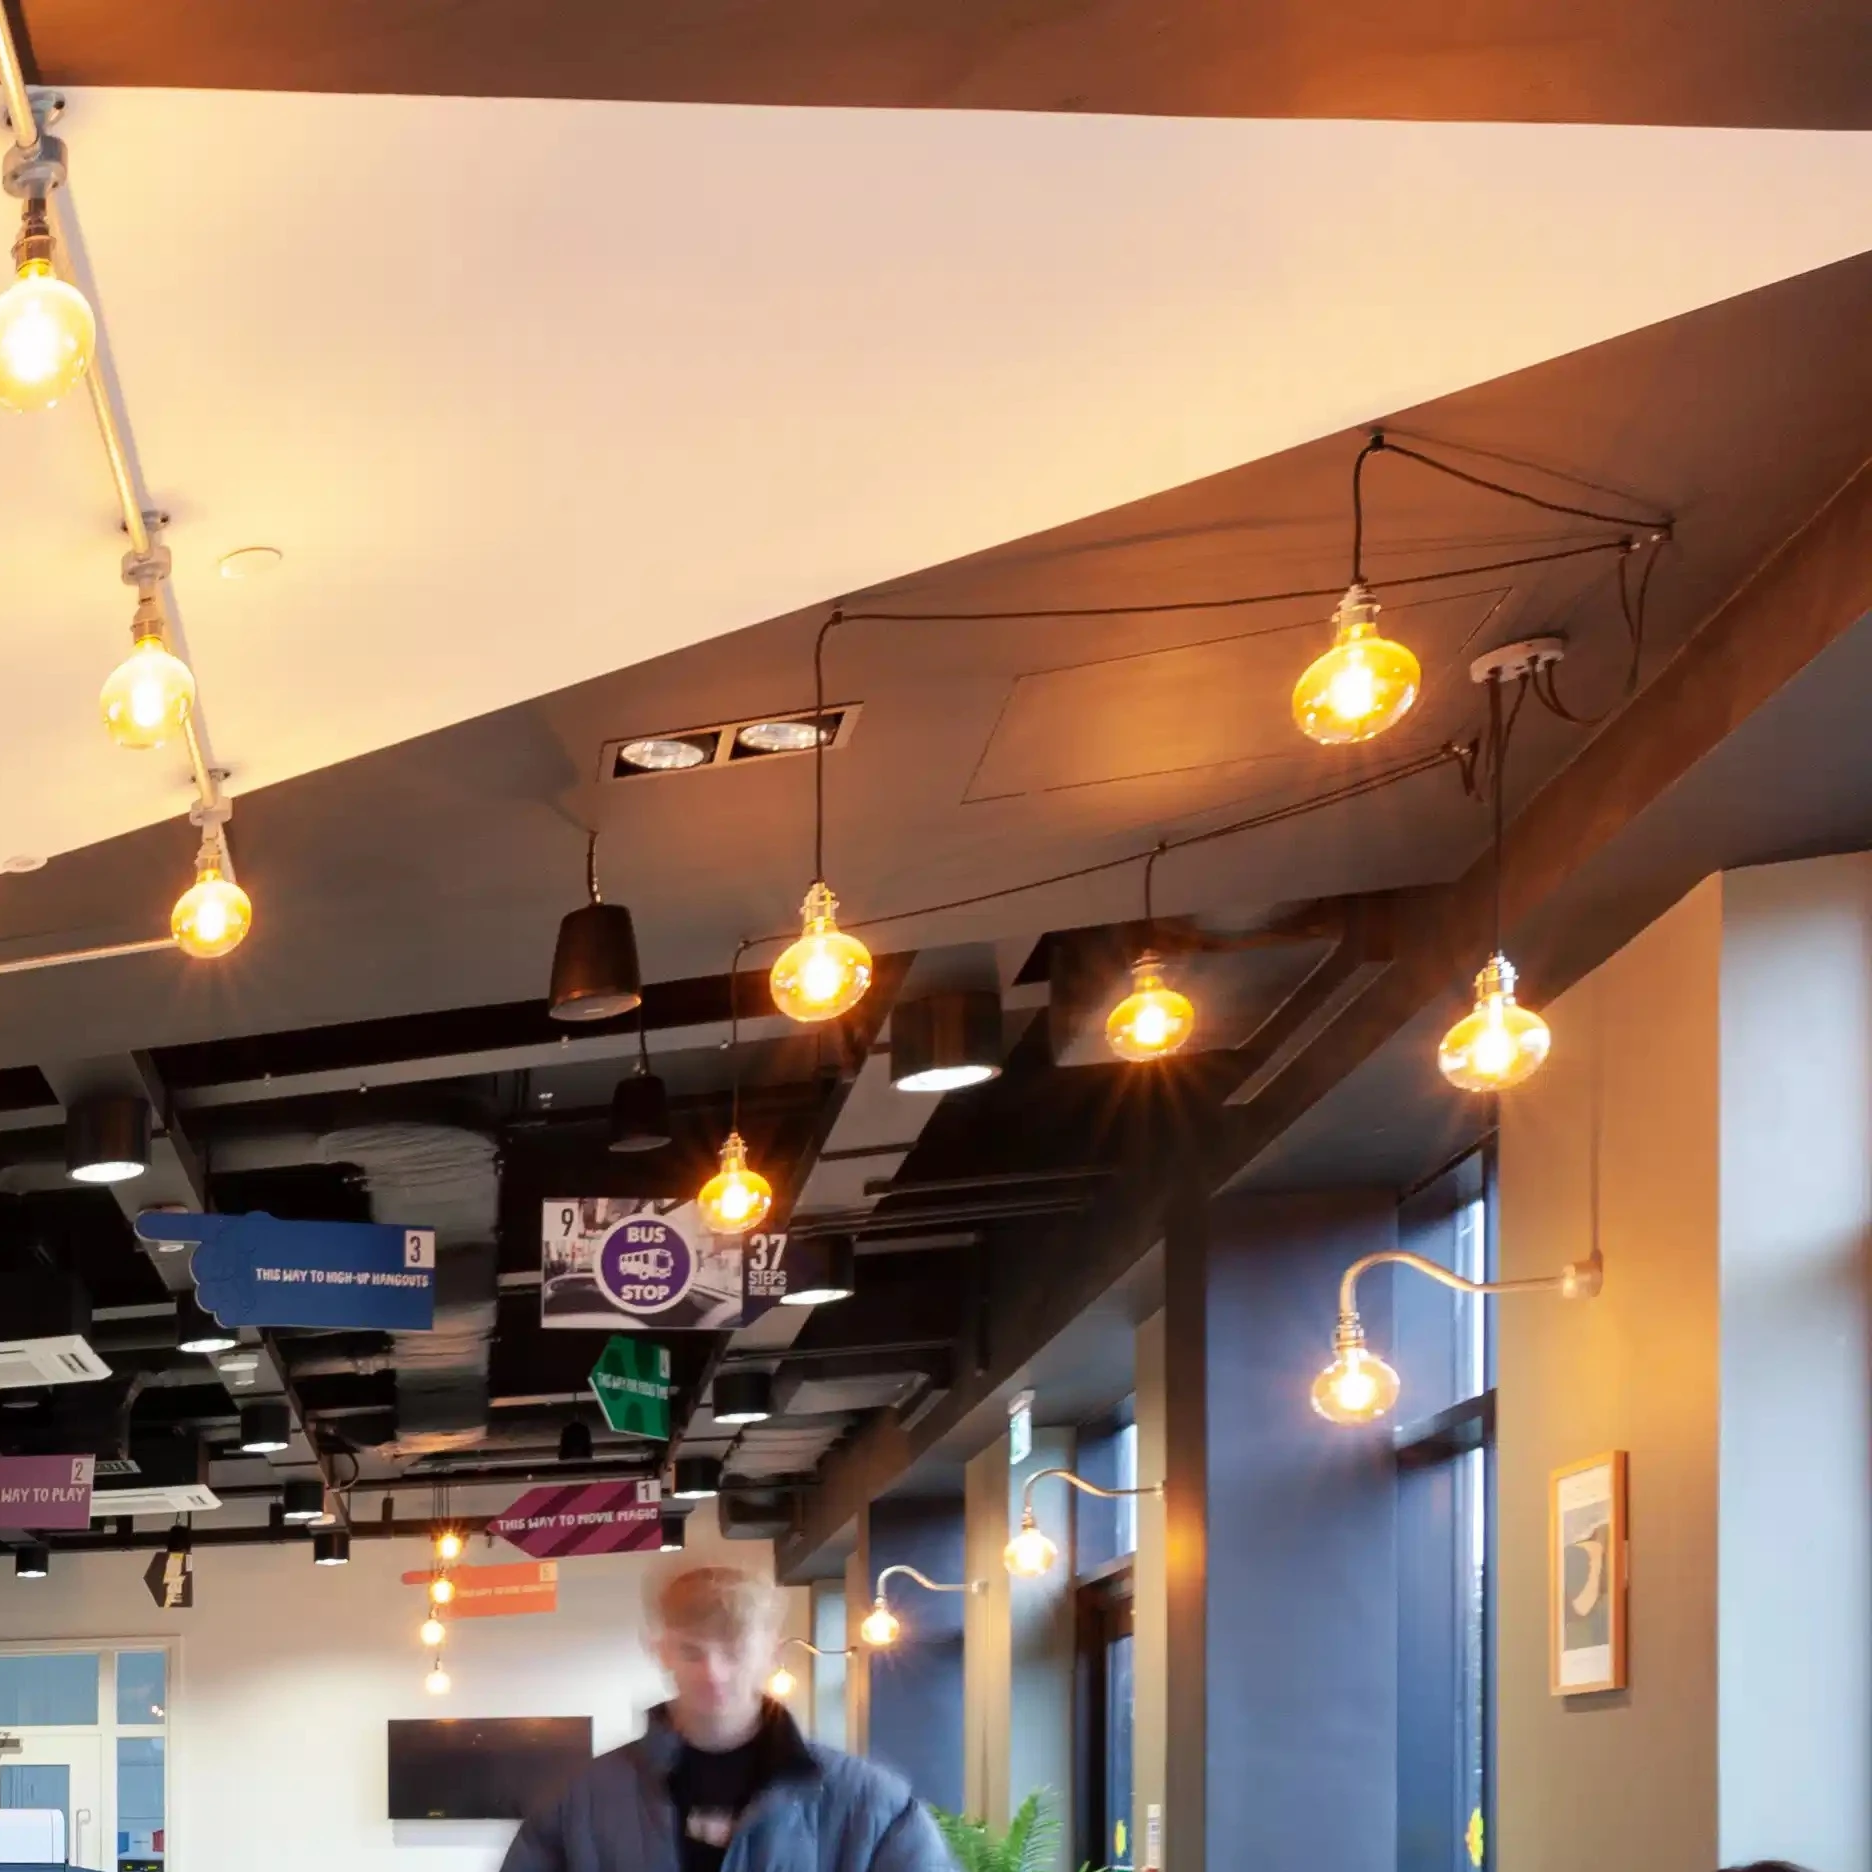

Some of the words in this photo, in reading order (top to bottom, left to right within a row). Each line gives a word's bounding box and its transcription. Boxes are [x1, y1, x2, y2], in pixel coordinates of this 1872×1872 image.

[561, 1208, 574, 1237] 9
[626, 1227, 666, 1243] BUS
[410, 1235, 421, 1263] 3
[749, 1233, 787, 1270] 37
[256, 1267, 281, 1281] THIS
[282, 1269, 308, 1283] WAY
[309, 1269, 324, 1283] TO
[325, 1271, 370, 1285] HIGH-UP
[372, 1273, 429, 1288] HANGOUTS
[748, 1270, 787, 1285] STEPS
[621, 1284, 670, 1301] STOP
[74, 1462, 84, 1480] 2
[1, 1487, 30, 1503] WAY
[33, 1488, 49, 1502] TO
[51, 1487, 85, 1503] PLAY
[641, 1484, 650, 1501] 1
[497, 1518, 526, 1531] THIS
[527, 1516, 556, 1529] WAY
[558, 1514, 575, 1527] TO
[577, 1511, 615, 1525] MOVIE
[617, 1507, 658, 1521] MAGIC
